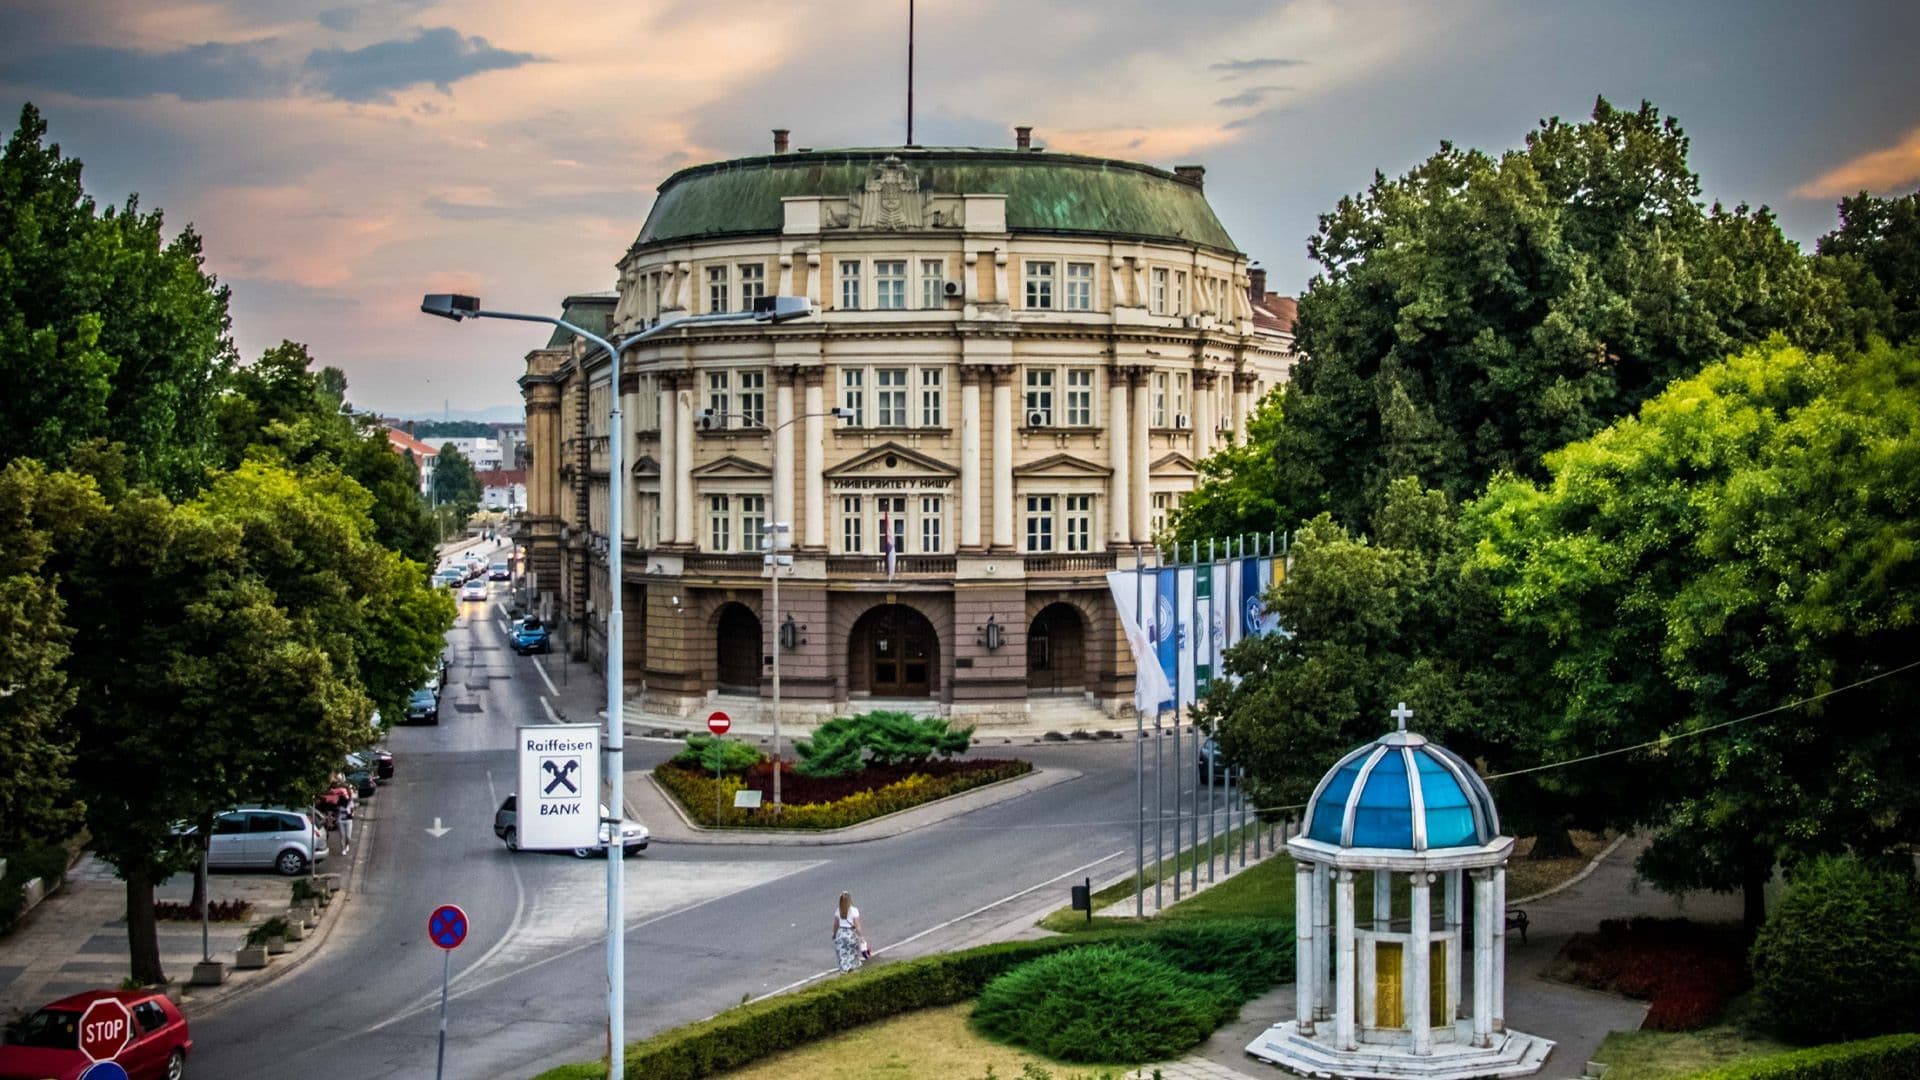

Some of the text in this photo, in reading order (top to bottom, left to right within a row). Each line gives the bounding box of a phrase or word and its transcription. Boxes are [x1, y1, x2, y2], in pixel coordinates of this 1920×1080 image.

[833, 479, 952, 489] УНИВЕРЗИТЕТ У НИШУ
[527, 739, 593, 752] Raiffeisen
[540, 803, 581, 816] BANK
[86, 1018, 124, 1043] STOP
